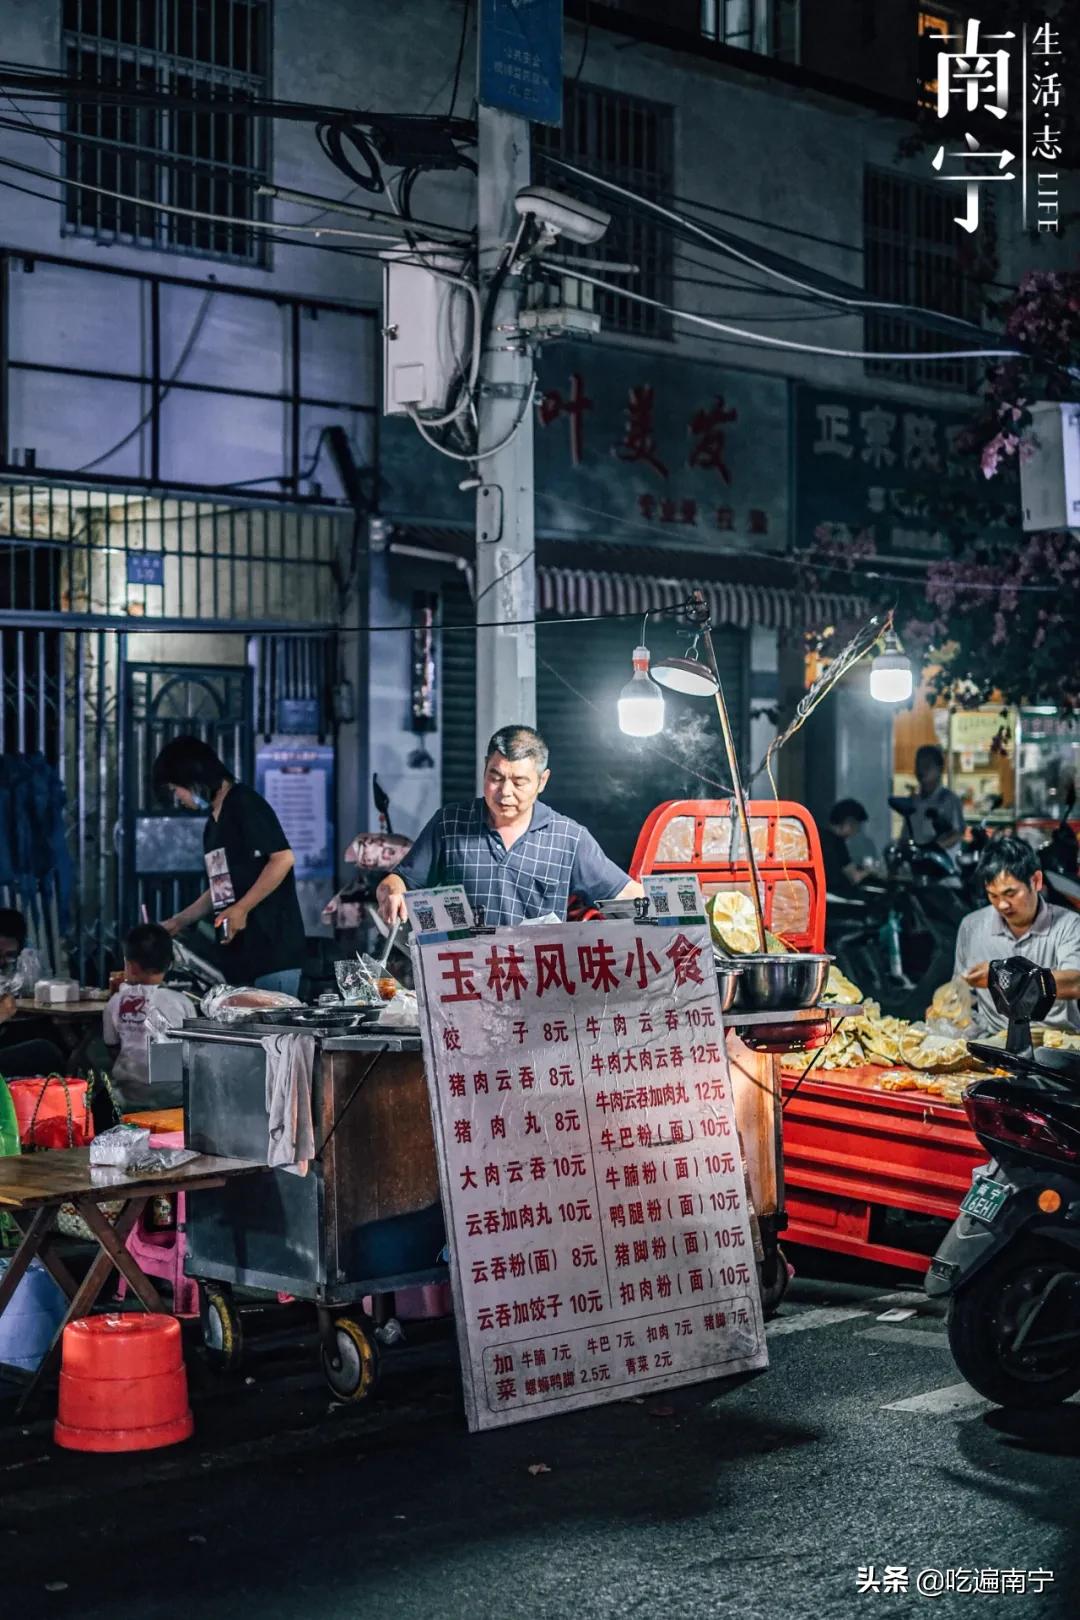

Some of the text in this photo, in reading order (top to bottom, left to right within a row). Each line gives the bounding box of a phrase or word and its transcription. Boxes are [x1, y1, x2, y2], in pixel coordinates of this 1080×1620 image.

[437, 932, 704, 1003] 玉林风味小食
[543, 1020, 569, 1042] 8元
[586, 1006, 716, 1039] 牛肉云吞 10元
[591, 1043, 721, 1075] 牛肉大肉云吞 12元
[449, 1064, 575, 1098] 猪肉云吞 8元
[596, 1079, 726, 1114] 牛肉云吞加肉丸 12元
[454, 1109, 581, 1144] 猪肉丸 8元
[700, 1116, 731, 1138] 10元
[459, 1155, 586, 1191] 大肉云吞 10元
[705, 1152, 736, 1175] 10元
[709, 1189, 741, 1212] 10元
[465, 1199, 592, 1237] 云吞加肉丸 10元
[714, 1226, 746, 1249] 10元
[572, 1245, 598, 1268] 8元
[719, 1263, 750, 1286] 10元
[477, 1290, 603, 1331] 云吞加饺子 10元
[552, 1344, 571, 1361] 7元
[587, 1337, 611, 1355] 牛巴
[616, 1331, 635, 1348] 7元
[646, 1324, 669, 1343] 扣肉
[674, 1319, 693, 1336] 7元
[731, 1308, 749, 1325] 7元
[492, 1353, 517, 1401] 加菜
[580, 1364, 610, 1383] 2.5元
[625, 1355, 649, 1375] 青菜
[654, 1350, 673, 1368] 2元
